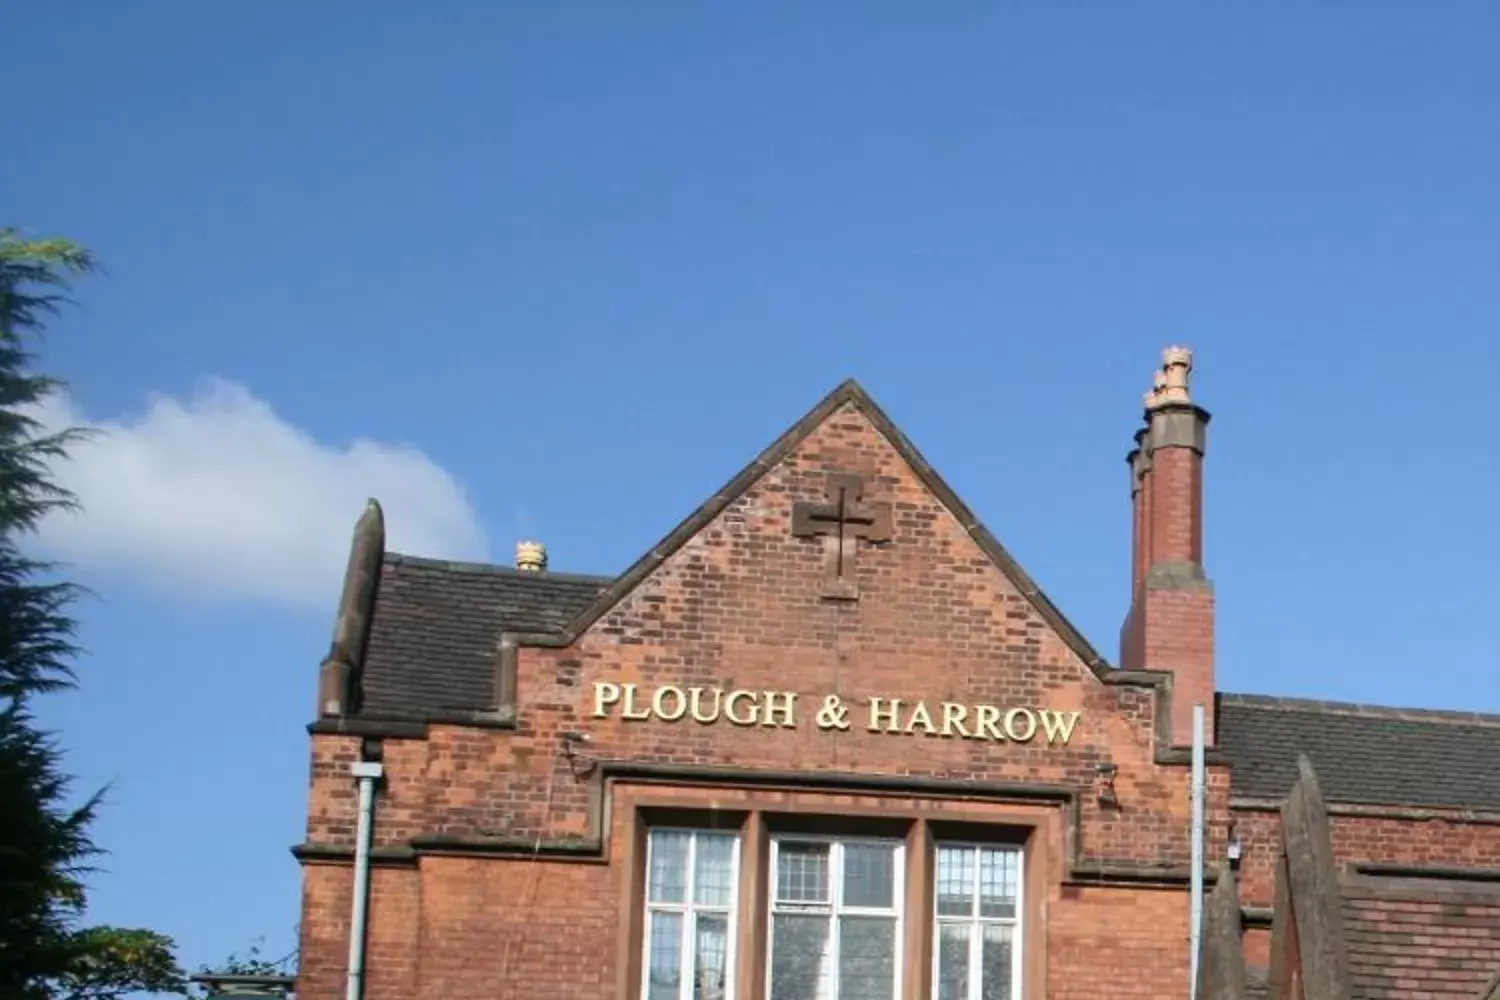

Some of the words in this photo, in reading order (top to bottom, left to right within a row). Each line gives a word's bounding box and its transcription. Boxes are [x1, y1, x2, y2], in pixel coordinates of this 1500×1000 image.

[592, 682, 798, 727] PLOUGH
[815, 695, 851, 729] &
[867, 697, 1081, 744] HARROW
